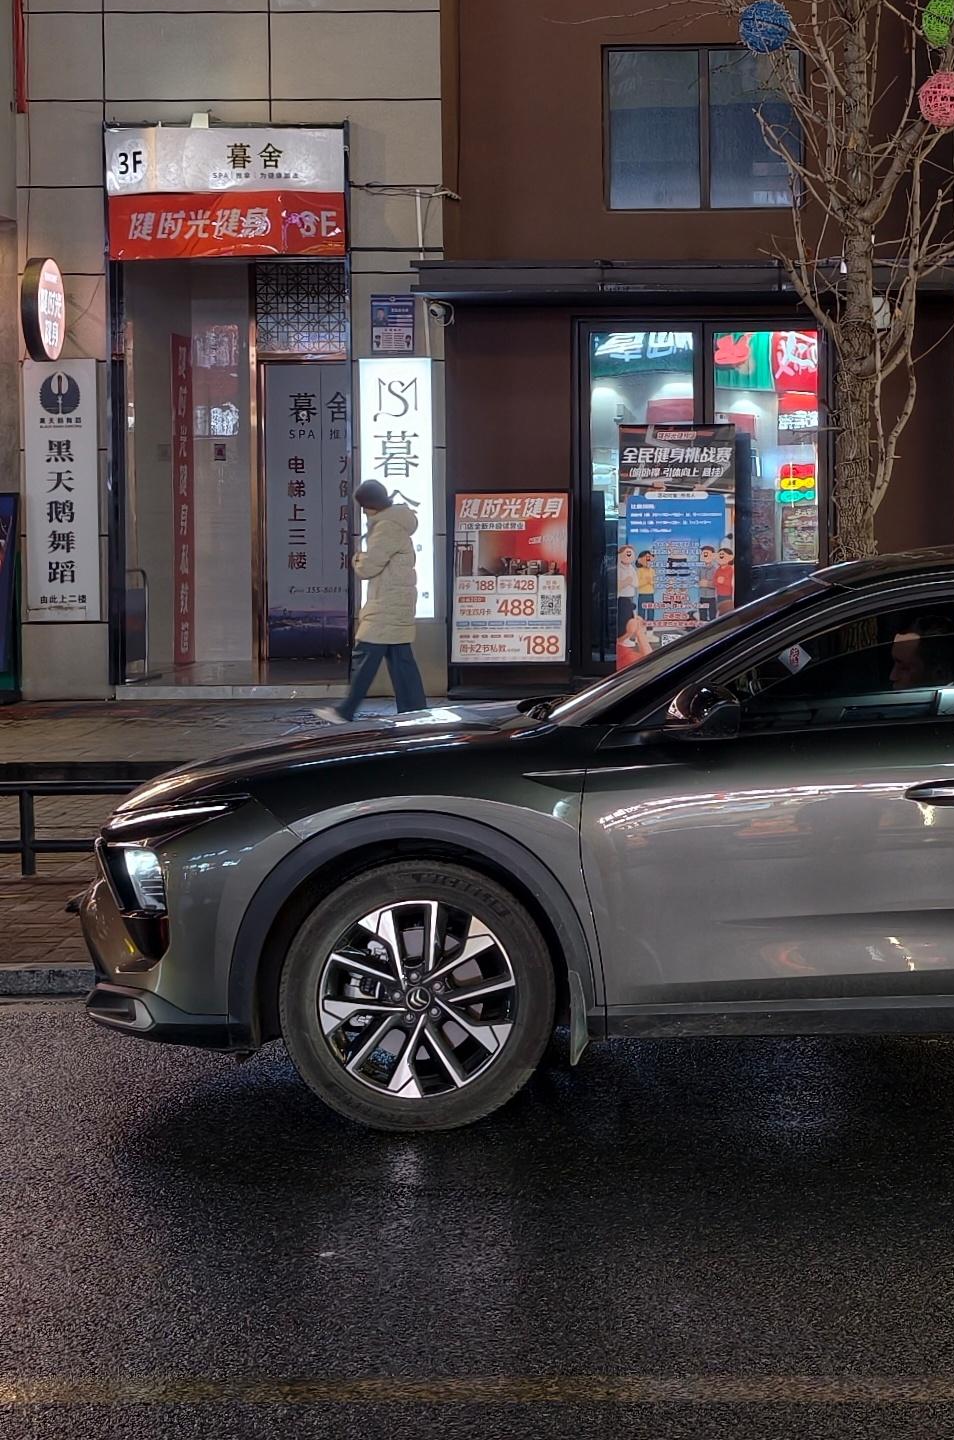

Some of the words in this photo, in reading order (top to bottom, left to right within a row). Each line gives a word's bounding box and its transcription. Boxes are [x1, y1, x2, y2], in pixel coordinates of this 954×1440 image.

[118, 150, 143, 174] 3F
[227, 142, 283, 170] 暮舍
[289, 428, 316, 440] SPA
[329, 428, 348, 440] 推
[621, 447, 733, 464] 全民健身挑战赛
[663, 467, 699, 477] 引体向上
[45, 439, 75, 584] 黑天鹅舞蹈
[287, 456, 307, 570] 电梯上三楼
[460, 498, 564, 519] 健时光健身
[40, 594, 87, 604] 由此上二楼
